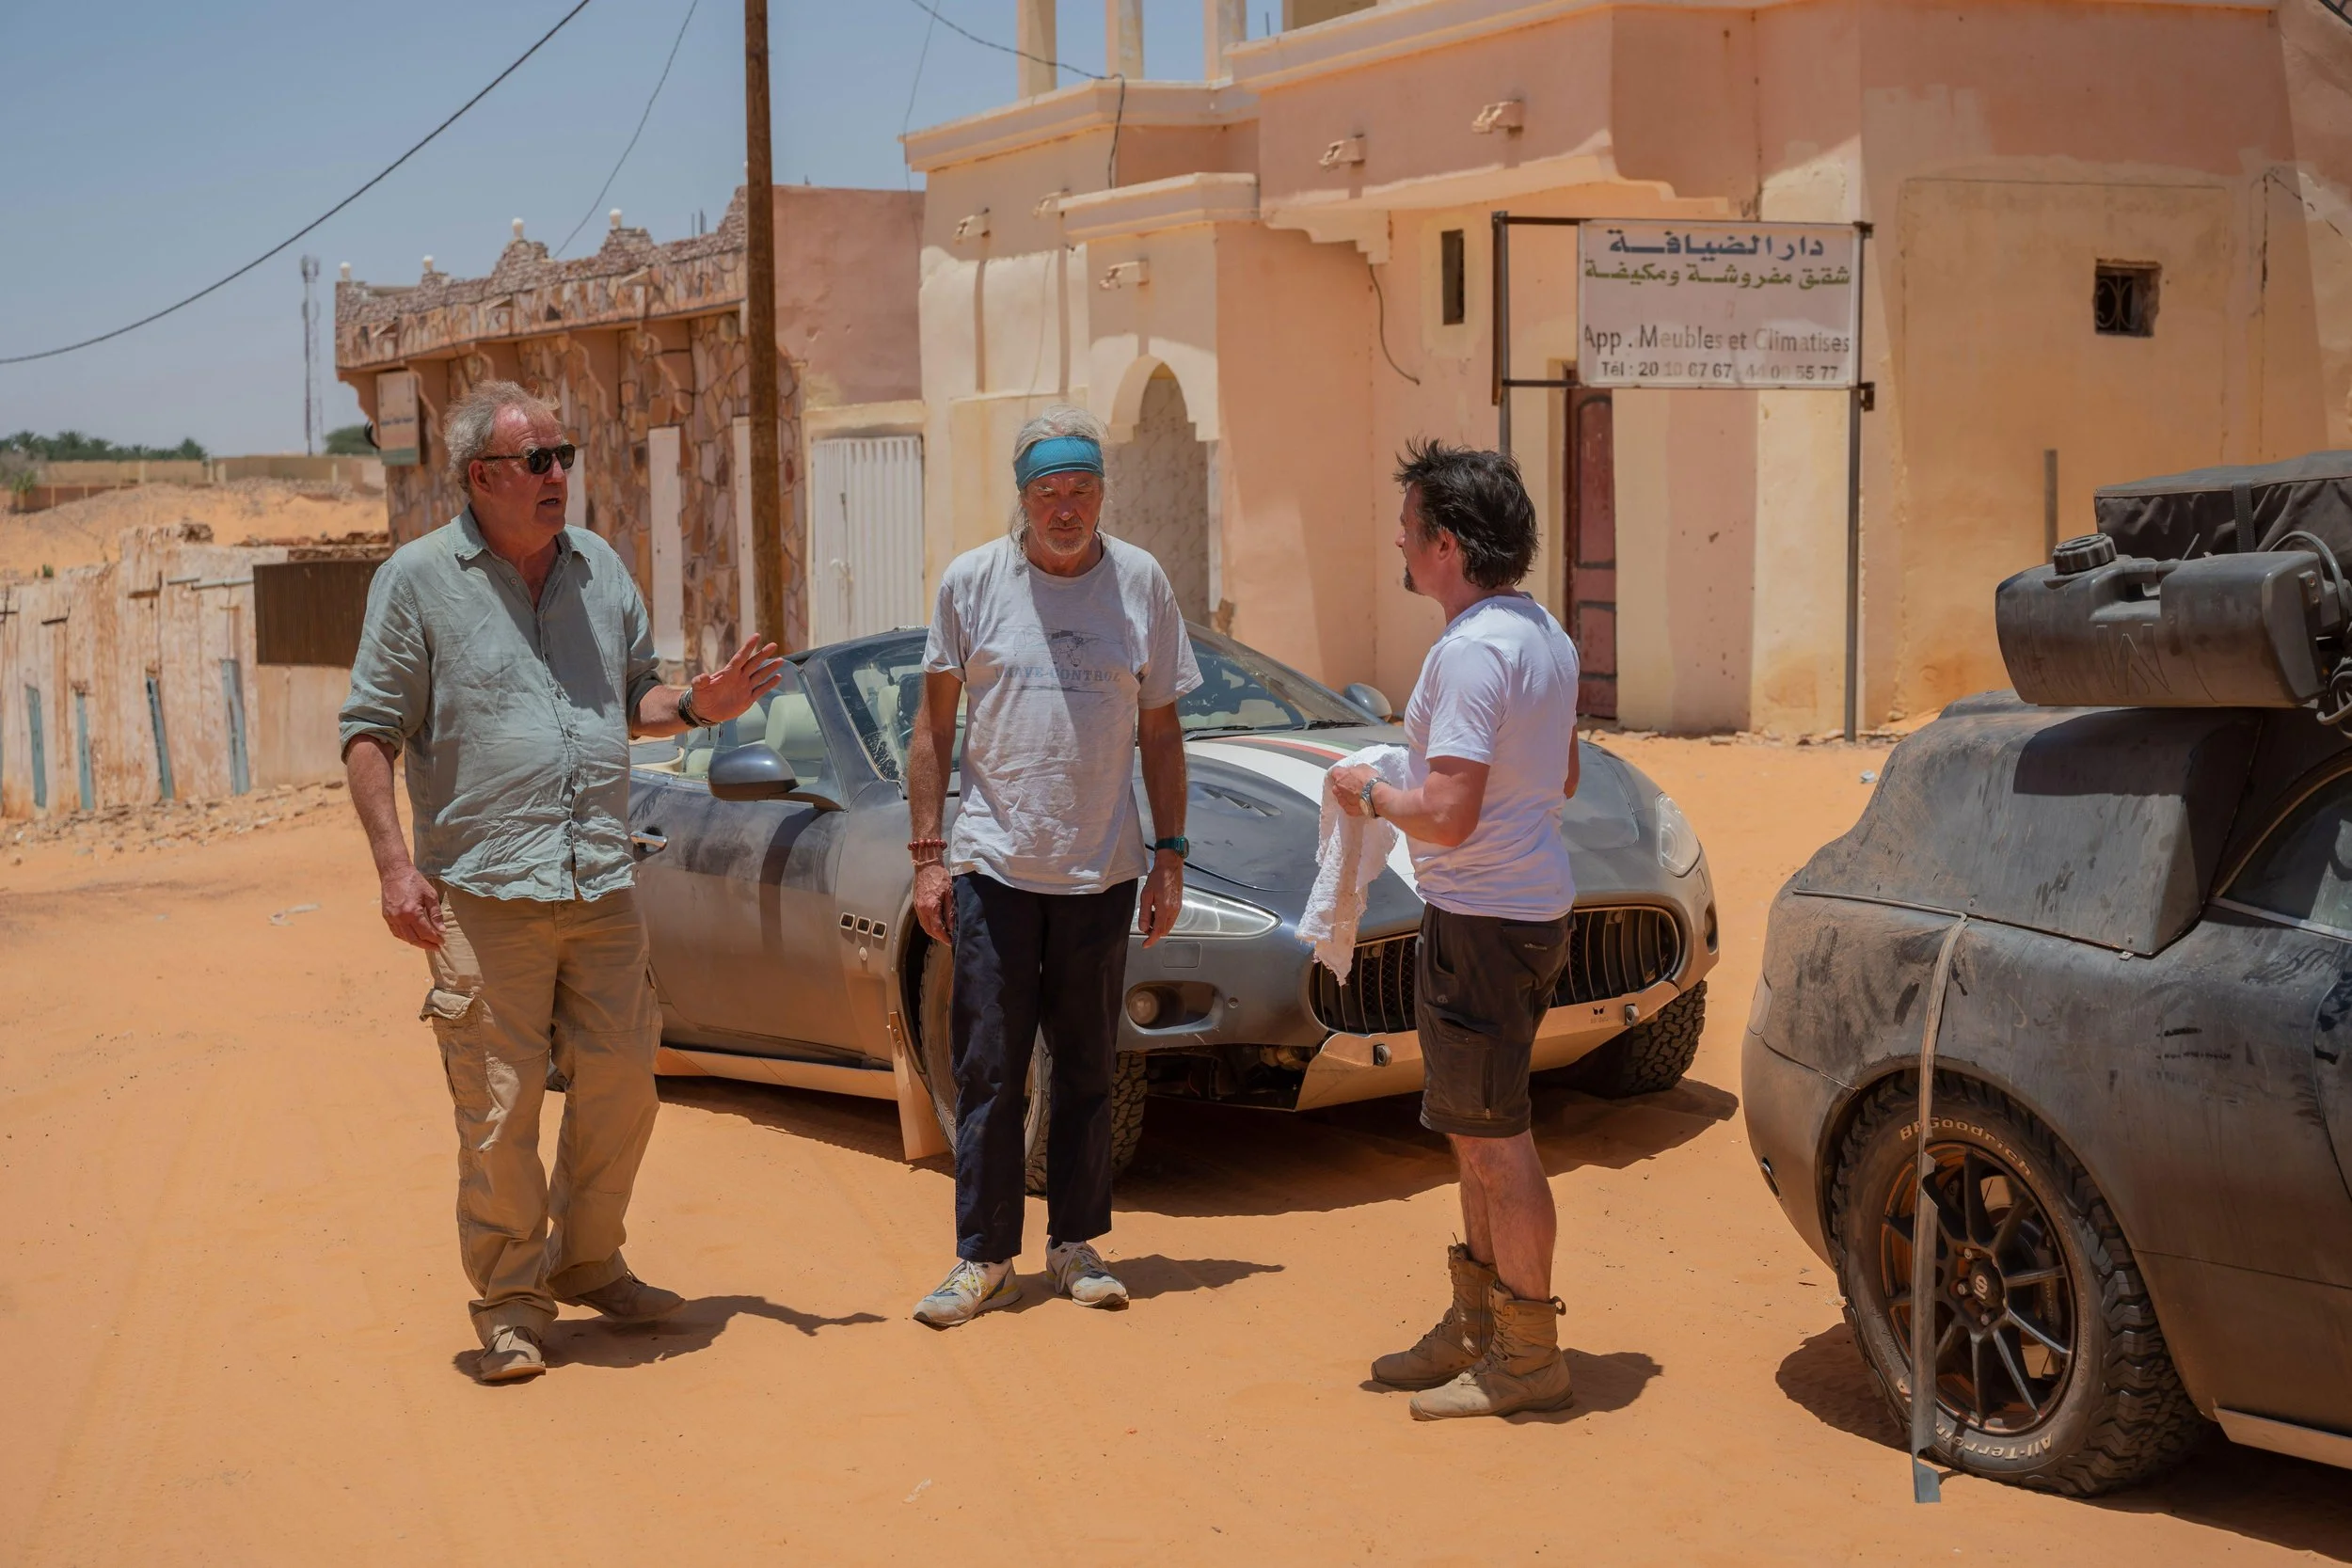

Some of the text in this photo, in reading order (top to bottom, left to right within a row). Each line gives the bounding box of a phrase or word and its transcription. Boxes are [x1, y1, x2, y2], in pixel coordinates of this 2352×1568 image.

[1776, 235, 1824, 261] دار
[1798, 265, 1851, 290] شقق
[1640, 324, 1723, 350] Meubles
[1728, 331, 1747, 351] et
[1638, 361, 1659, 376] 20
[1688, 362, 1708, 377] 67
[1712, 363, 1732, 378] 67
[1796, 365, 1815, 380] 55
[1820, 365, 1838, 380] 77
